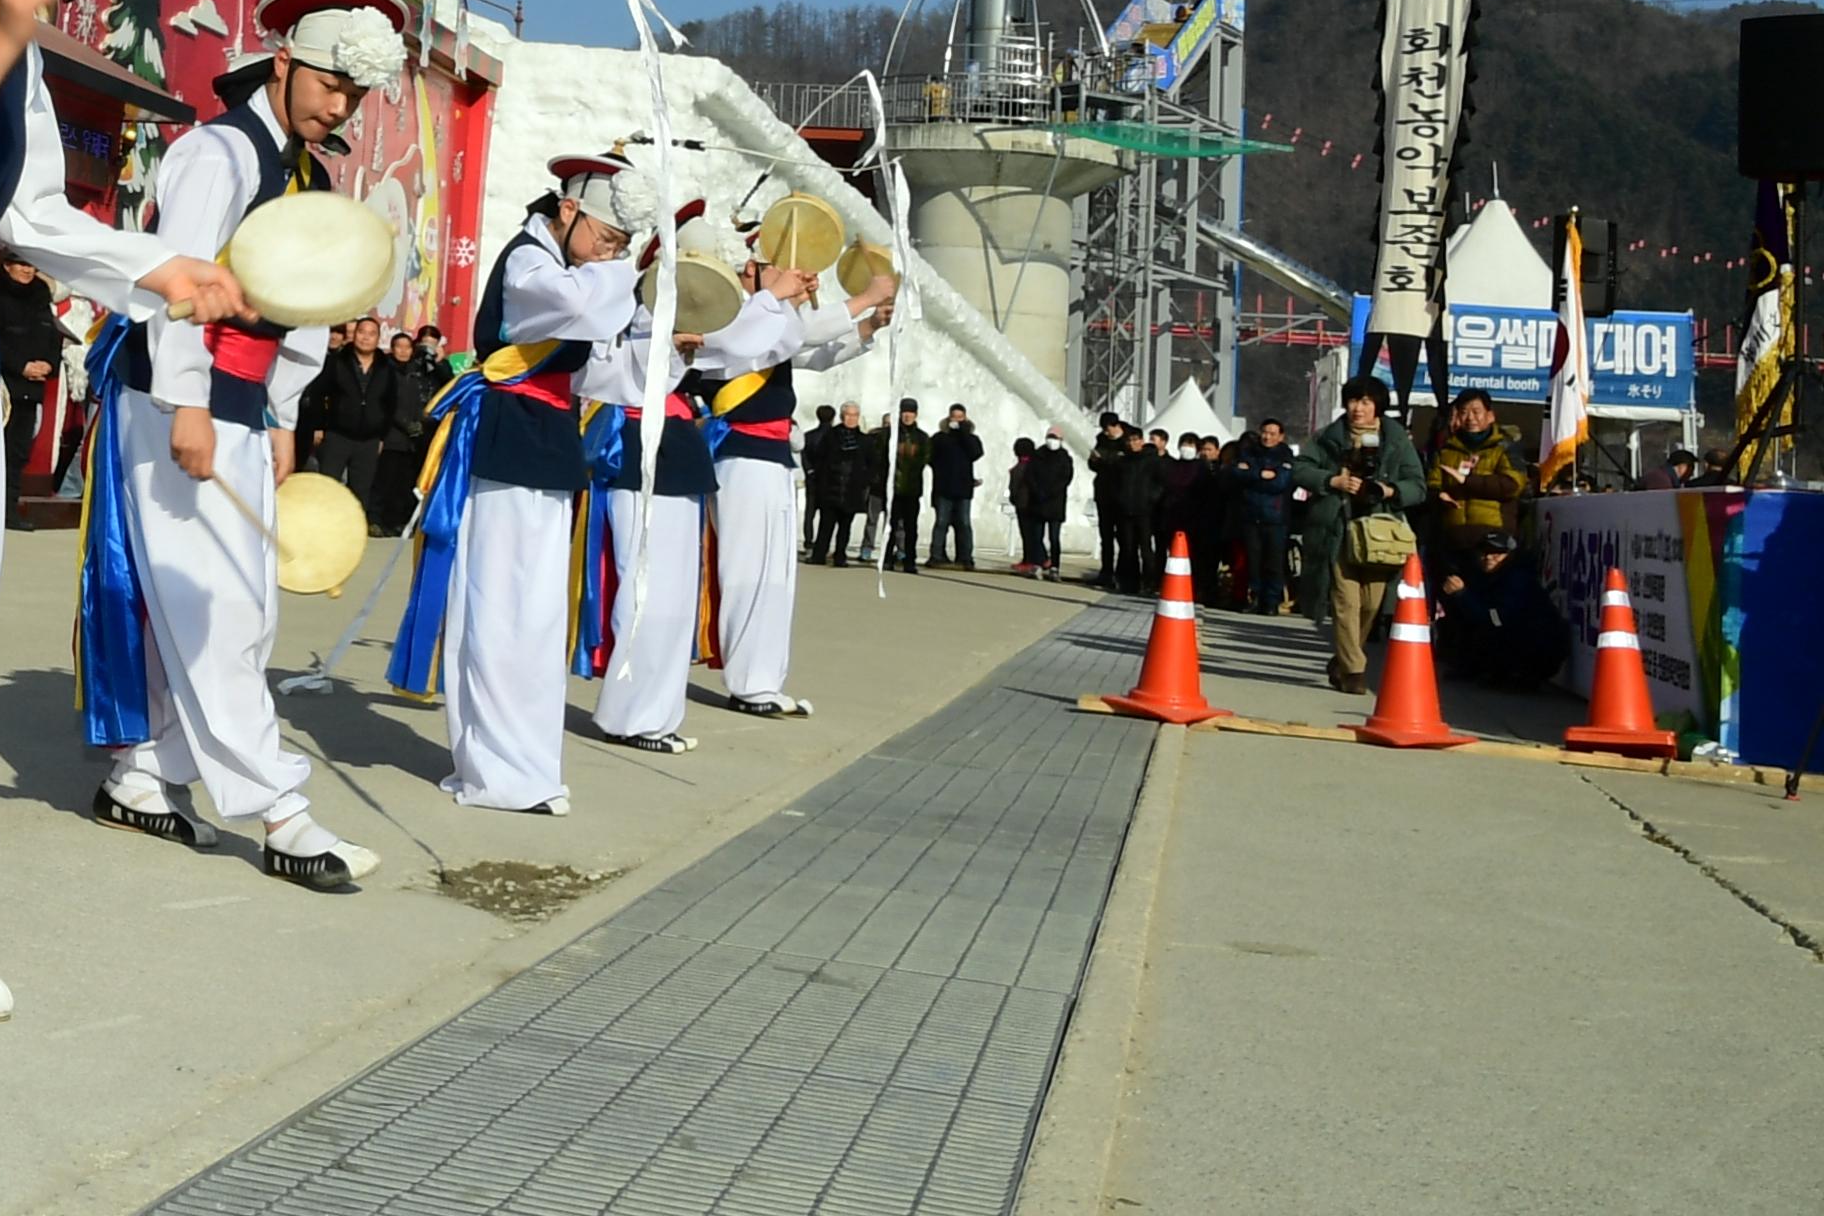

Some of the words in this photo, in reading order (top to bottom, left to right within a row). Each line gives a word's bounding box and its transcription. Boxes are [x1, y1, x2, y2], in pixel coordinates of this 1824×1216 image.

[1381, 22, 1452, 302] 화천농악보존회
[1419, 315, 1558, 370] 음썰
[1592, 322, 1676, 378] 대여
[1469, 375, 1502, 390] rental
[1507, 376, 1540, 393] booth
